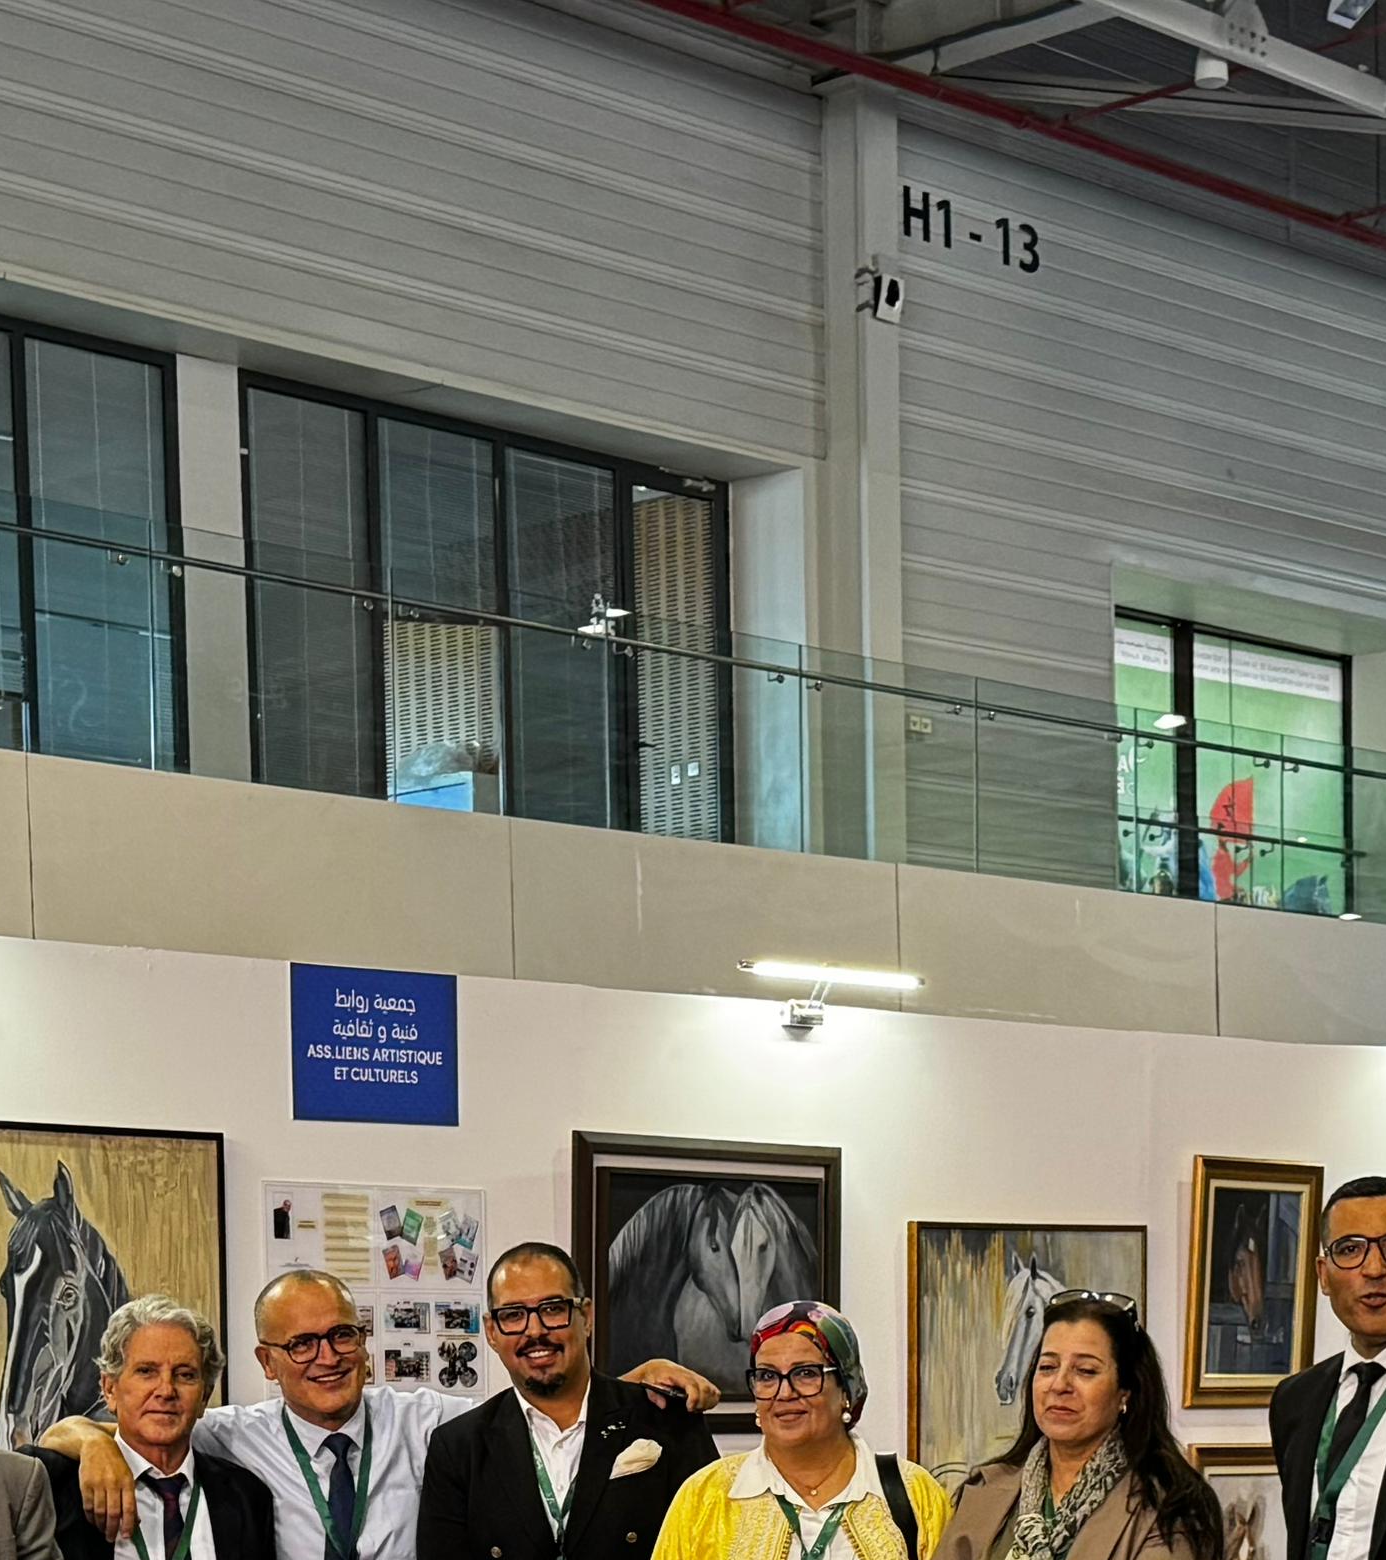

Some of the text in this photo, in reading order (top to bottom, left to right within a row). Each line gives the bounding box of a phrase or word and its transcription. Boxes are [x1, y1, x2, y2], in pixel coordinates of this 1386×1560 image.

[334, 988, 416, 1016] جمعية روابط
[332, 1017, 418, 1044] فنية و ثقافية
[372, 1048, 443, 1065] ARTISTIQUE
[334, 1066, 419, 1084] ET CULTURELS
